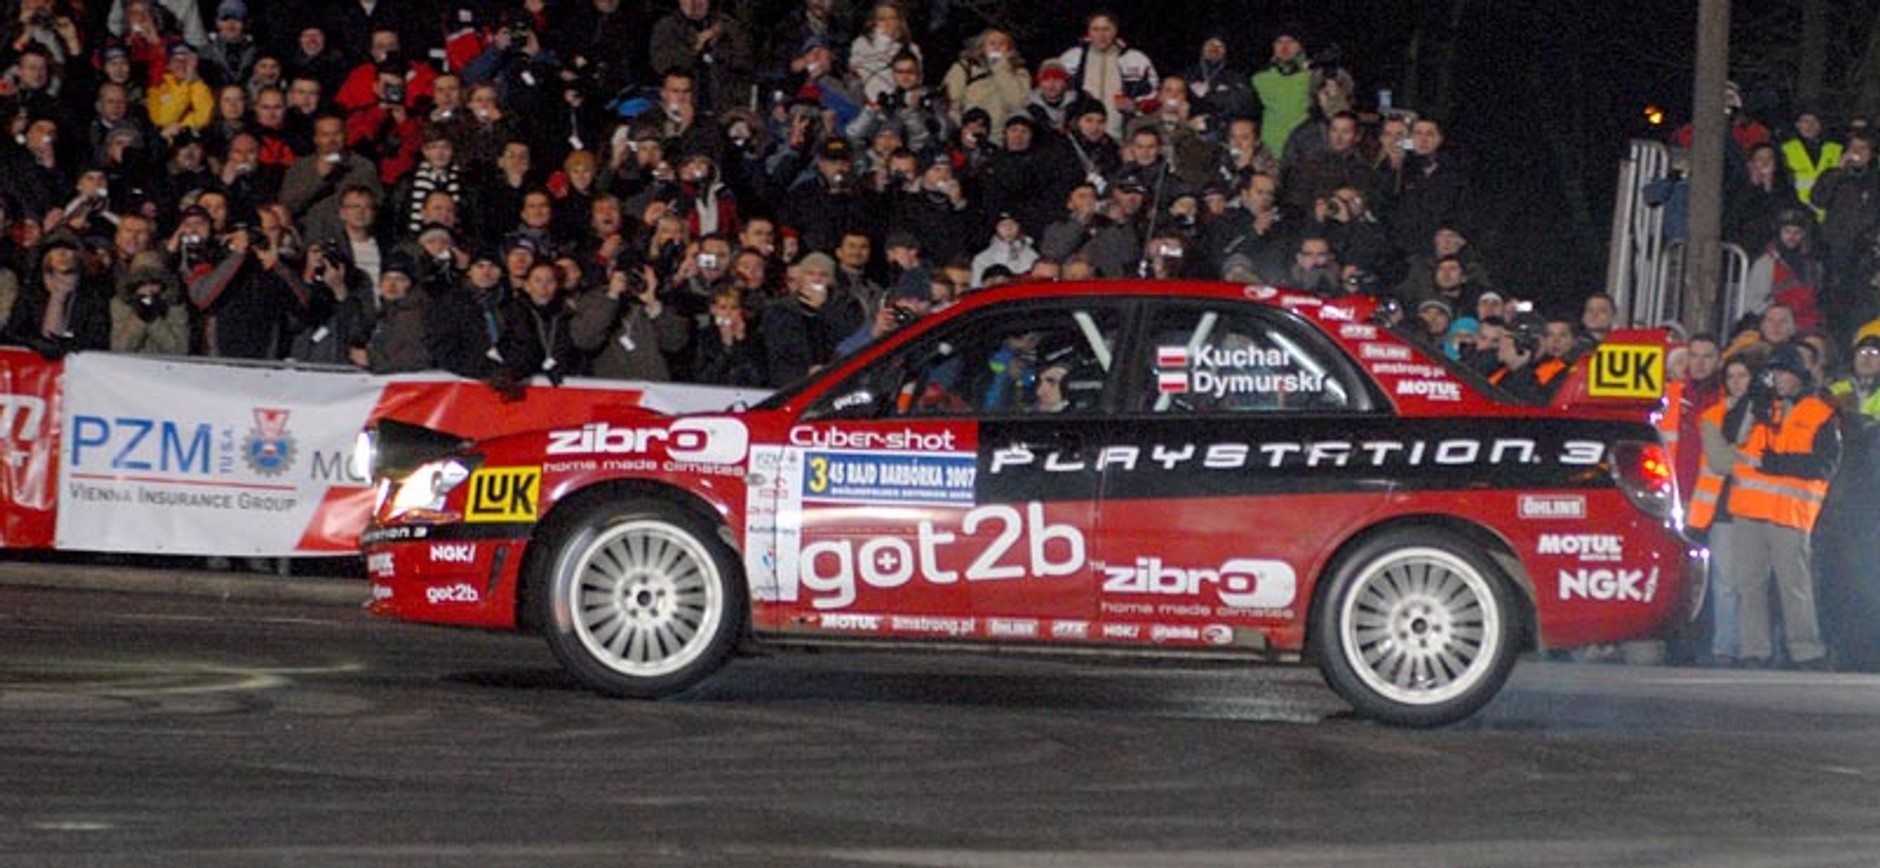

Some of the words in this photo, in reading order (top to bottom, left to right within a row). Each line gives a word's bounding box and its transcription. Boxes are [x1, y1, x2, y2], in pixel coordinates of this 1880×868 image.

[1194, 346, 1291, 369] Kuchar
[1194, 371, 1323, 398] Dymurski
[1397, 381, 1461, 399] MOTUL
[71, 415, 212, 474] PZM
[545, 416, 749, 464] zibro
[789, 425, 956, 450] Cyber-shot
[543, 460, 597, 472] home
[603, 459, 657, 471] made
[663, 461, 745, 476] climates
[809, 457, 827, 492] 3
[799, 502, 1085, 608] got2b
[1537, 535, 1623, 554] MOTUL
[426, 584, 479, 603] got2b
[1102, 556, 1296, 608] zibro
[1559, 569, 1643, 601] NGK
[1101, 602, 1153, 614] home
[1159, 605, 1211, 616] made
